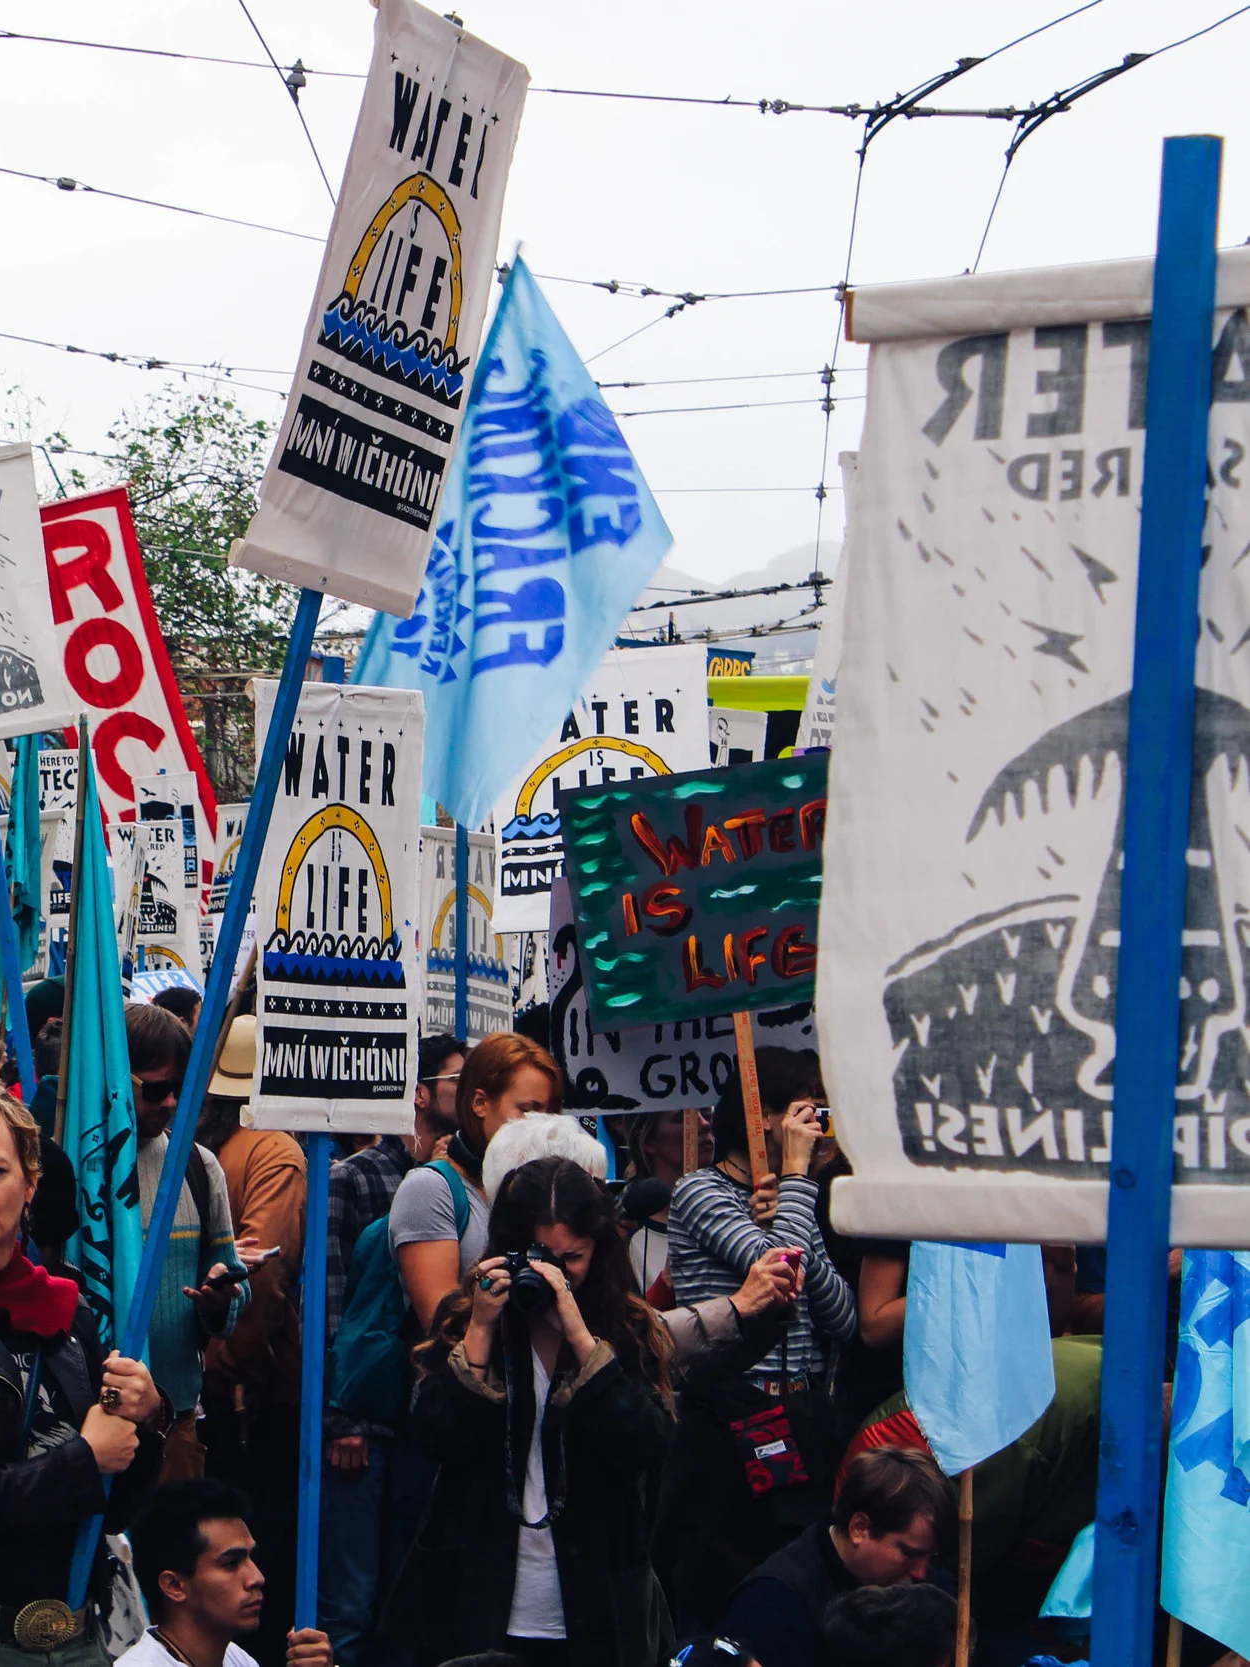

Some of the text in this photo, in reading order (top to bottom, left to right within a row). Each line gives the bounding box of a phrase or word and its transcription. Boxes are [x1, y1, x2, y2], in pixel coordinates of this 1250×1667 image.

[560, 698, 676, 743] ATER
[282, 731, 396, 806] WATER
[589, 750, 604, 767] IS
[118, 827, 175, 843] WTER
[307, 864, 368, 933] LIFE
[622, 881, 692, 937] IS
[683, 925, 817, 993] LIFE
[263, 1034, 406, 1082] MNÍ WIČHÓNI
